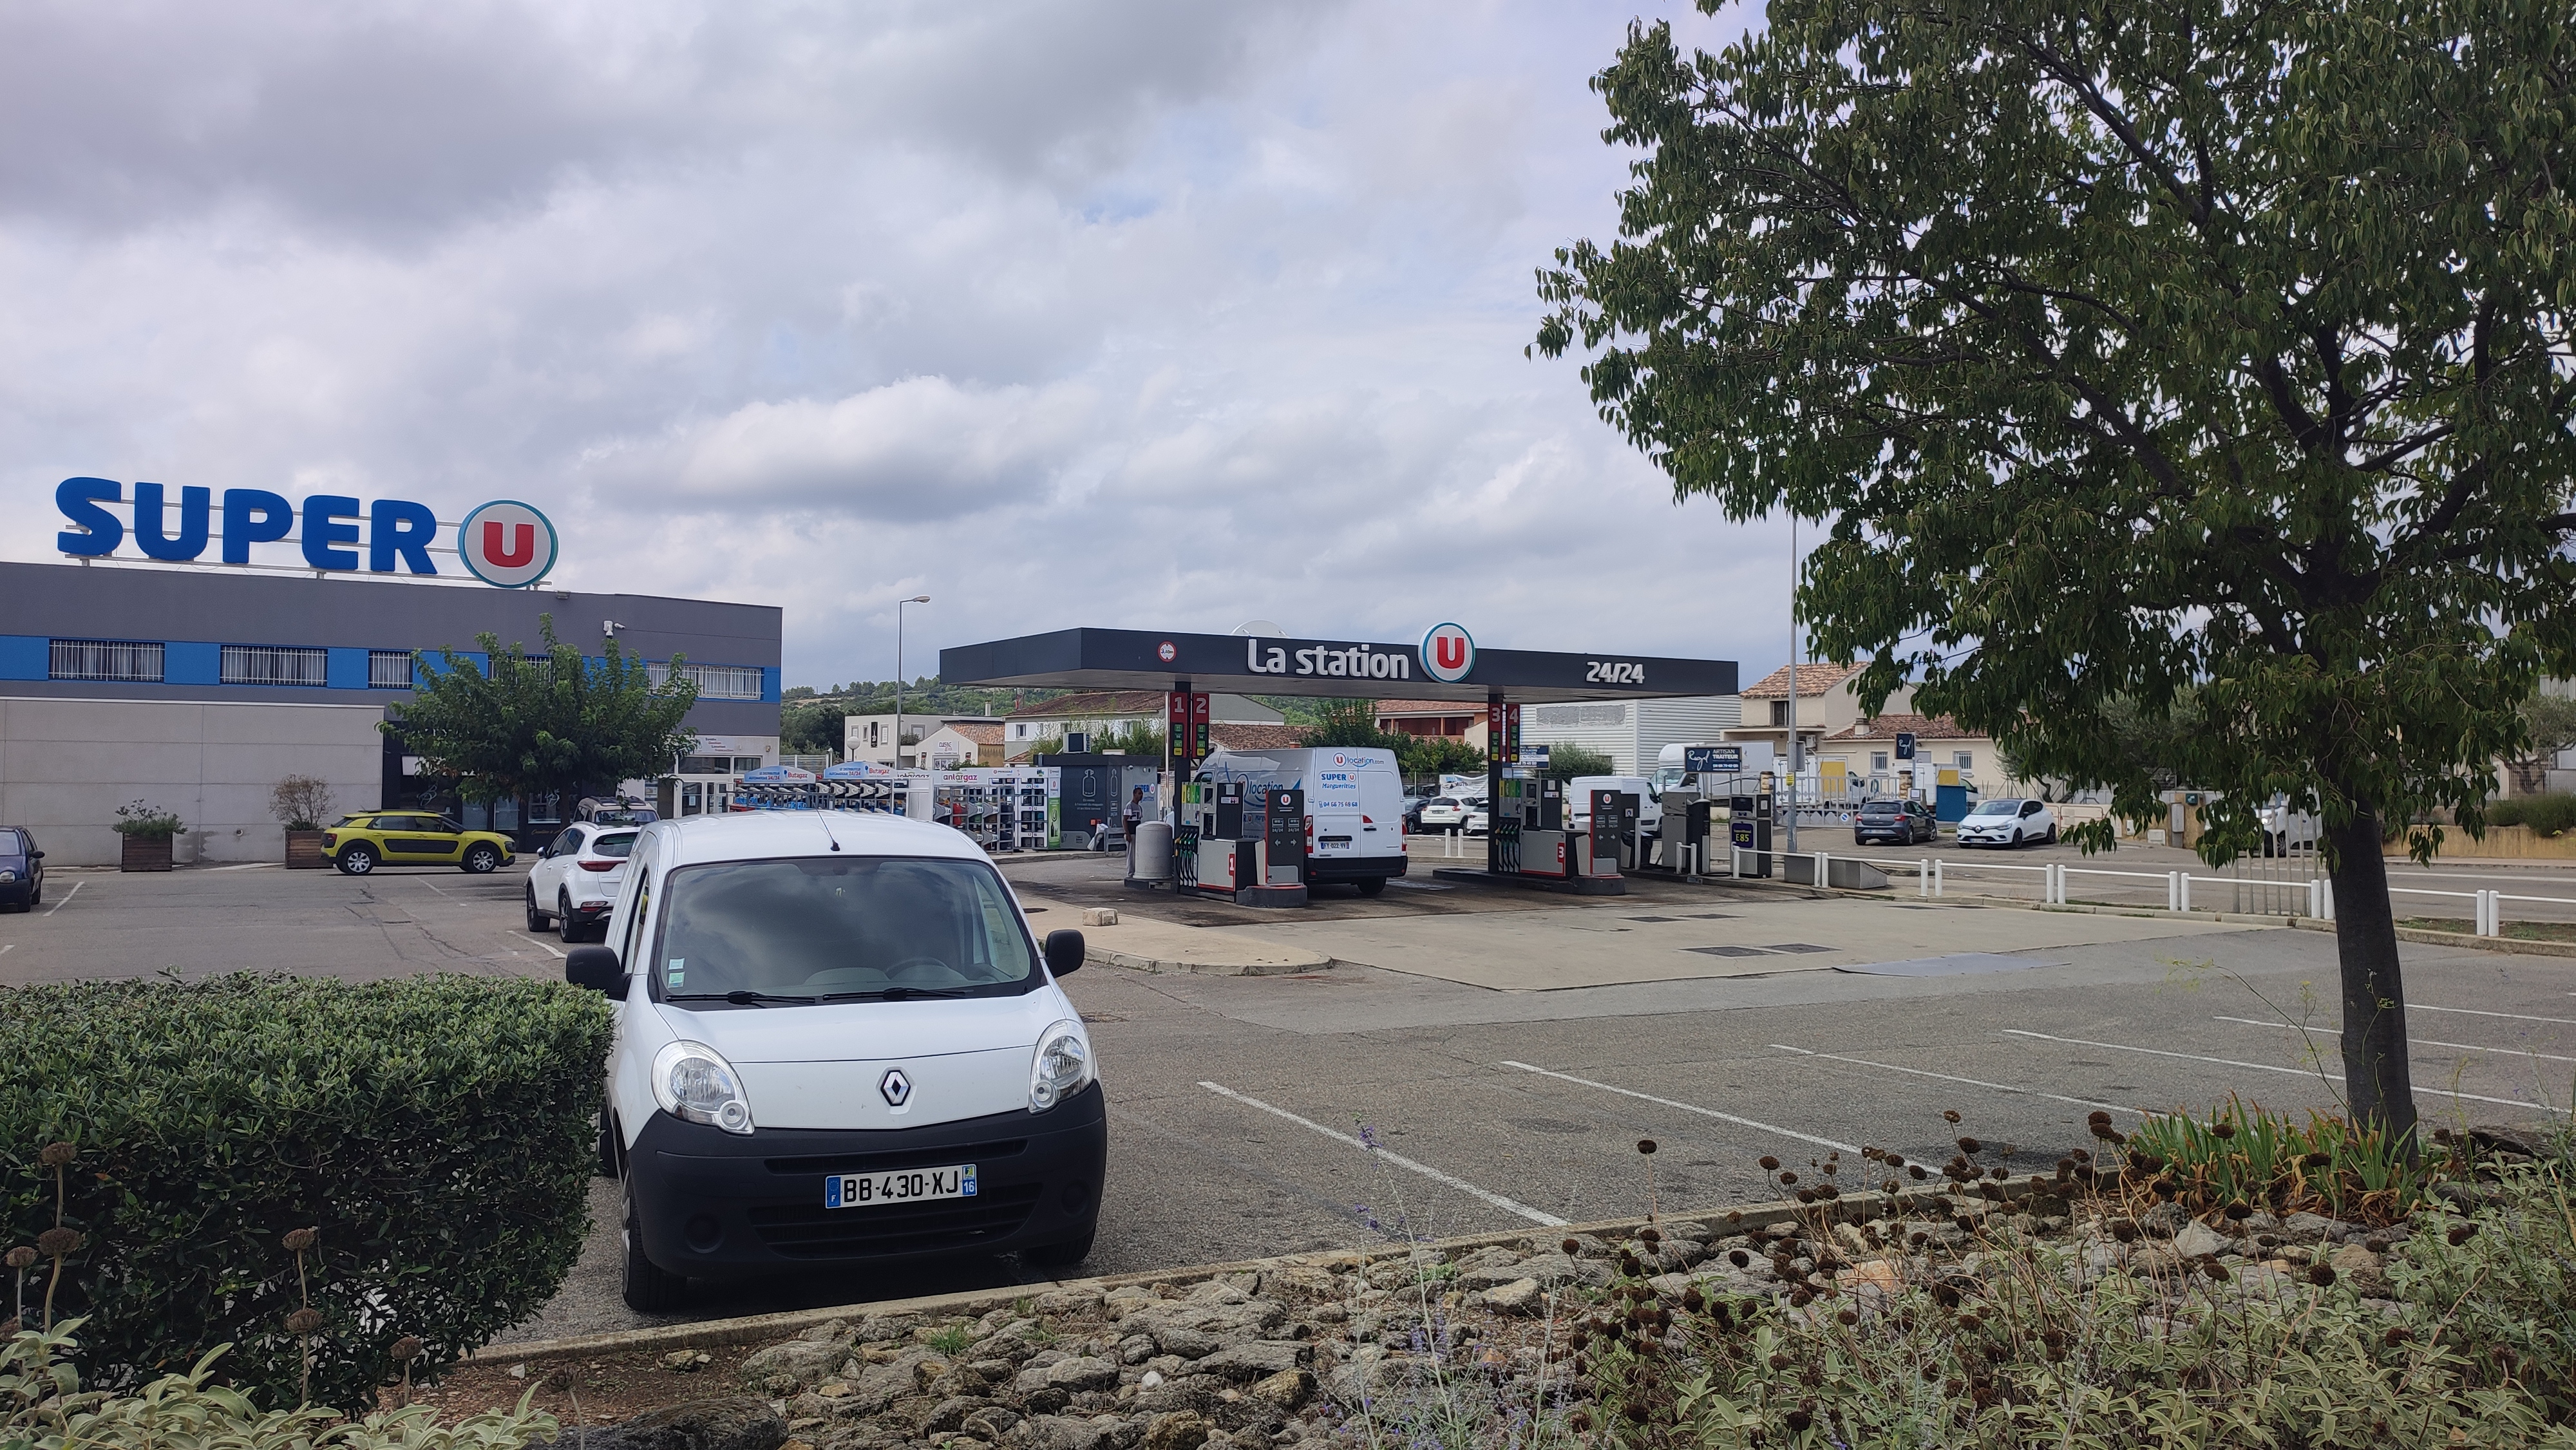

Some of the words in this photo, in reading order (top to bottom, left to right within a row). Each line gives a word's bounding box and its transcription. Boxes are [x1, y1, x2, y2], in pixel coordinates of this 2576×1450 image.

[55, 476, 438, 575] SUPER
[483, 521, 535, 568] U
[1247, 639, 1287, 673] La
[1295, 644, 1409, 679] station
[1436, 636, 1465, 670] U
[1586, 661, 1645, 684] 24/24
[1174, 696, 1184, 713] 1
[1196, 697, 1207, 714] 2
[1492, 707, 1501, 722] 3
[1509, 708, 1519, 723] 4
[943, 773, 978, 782] antargaz
[1735, 833, 1750, 842] E85
[1558, 846, 1564, 858] 3
[1229, 857, 1235, 871] 1
[844, 1170, 958, 1203] BB-430-XJ
[963, 1180, 974, 1193] 16
[831, 1194, 837, 1203] F
